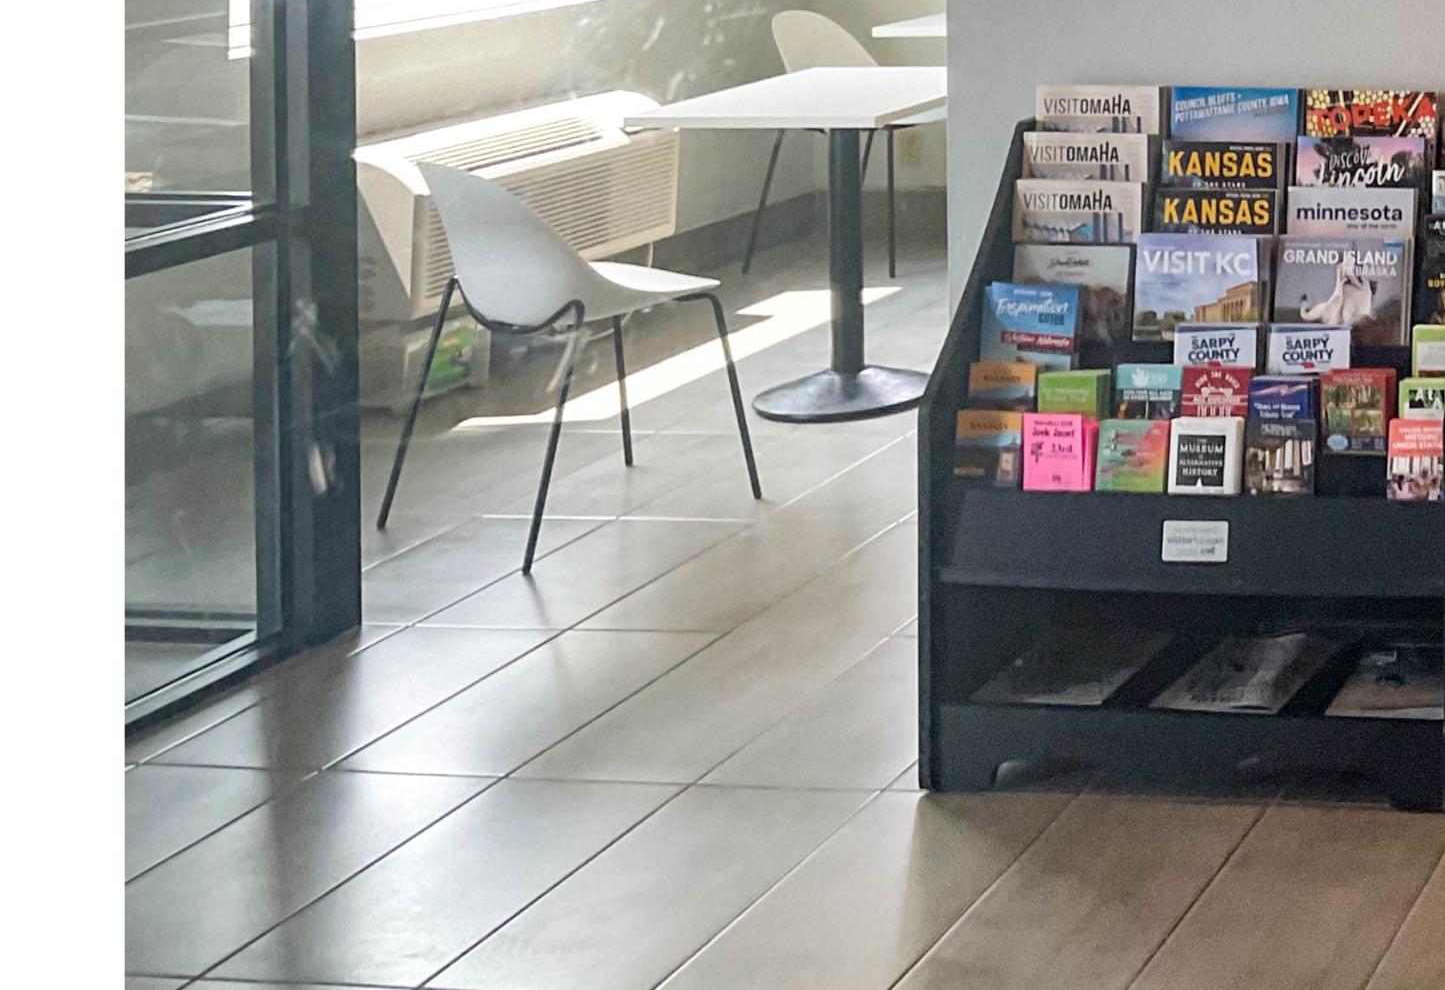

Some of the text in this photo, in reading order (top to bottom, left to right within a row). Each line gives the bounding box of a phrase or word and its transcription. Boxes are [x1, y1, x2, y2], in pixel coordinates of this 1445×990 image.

[1307, 96, 1436, 132] TOPEKA
[1168, 151, 1273, 178] KANSAS
[1319, 157, 1405, 188] Lincoln
[1163, 197, 1270, 226] KANSAS
[1296, 202, 1403, 221] minnesota
[1142, 249, 1251, 275] VISIT KC
[1283, 248, 1340, 265] GRAND
[1191, 336, 1236, 350] SARPY
[1286, 337, 1330, 350] SARPY
[1188, 348, 1241, 362] COUNTY
[1282, 349, 1334, 362] COUNTY
[1180, 443, 1224, 453] MUSEUM
